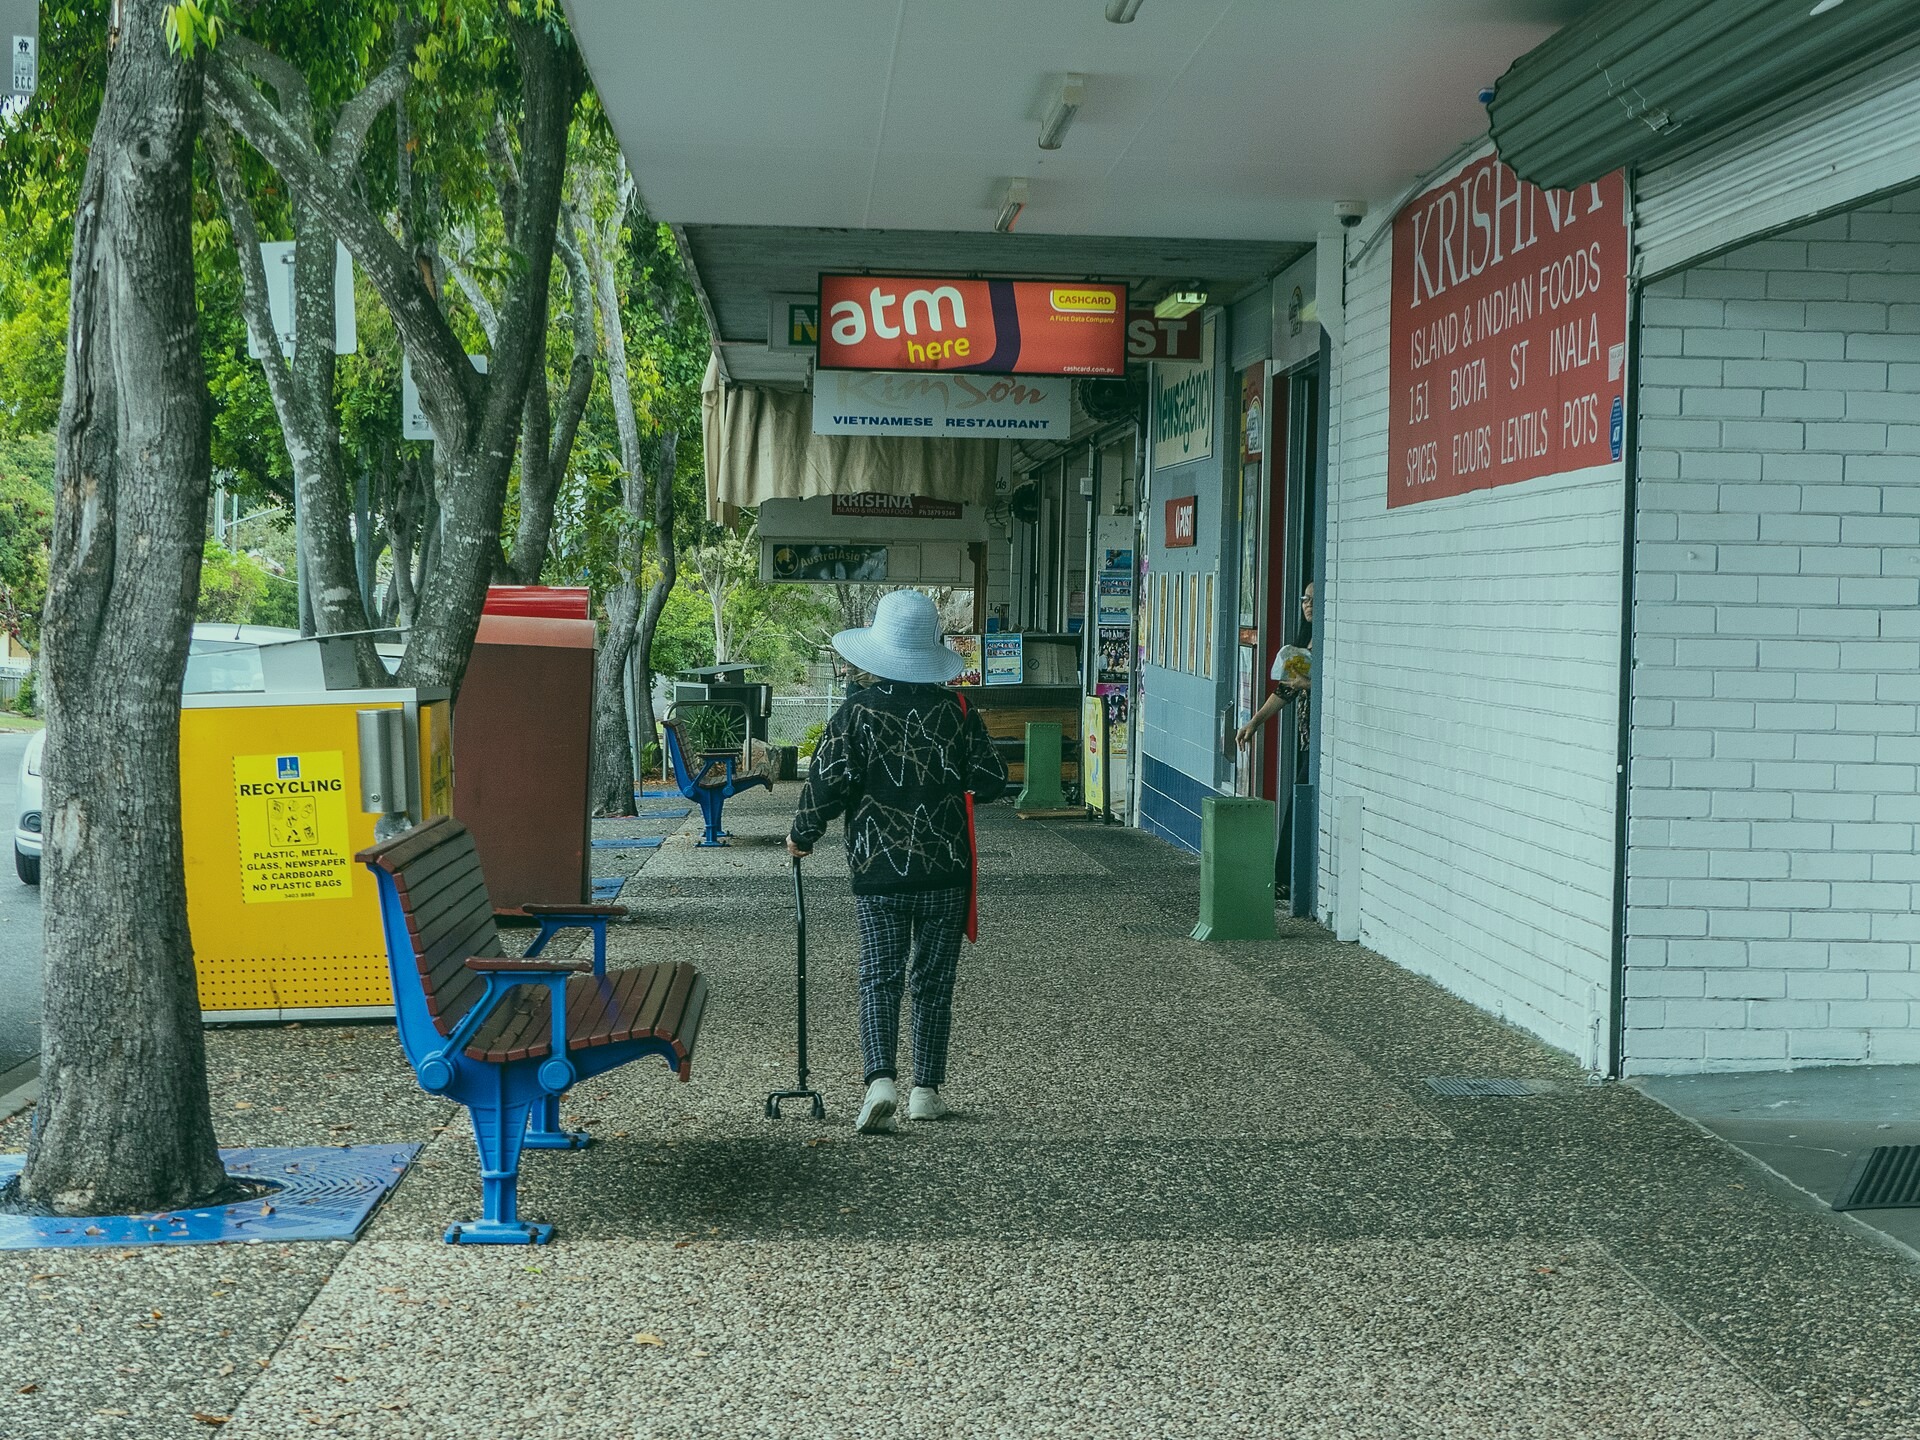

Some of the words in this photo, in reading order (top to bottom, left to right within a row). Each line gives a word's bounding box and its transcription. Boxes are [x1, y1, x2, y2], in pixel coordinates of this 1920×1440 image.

[1058, 295, 1111, 305] CASHCARD
[1410, 312, 1459, 370] ISLAND
[1462, 304, 1472, 348] &
[1477, 274, 1532, 342] INDIAN
[1539, 241, 1601, 315] FOODS
[831, 286, 967, 345] atm
[907, 337, 971, 363] here
[1063, 366, 1115, 374] cashcard.com.au
[1408, 383, 1430, 425] 151
[1450, 357, 1487, 411] BIOTA
[1509, 339, 1530, 390] ST
[1550, 312, 1600, 377] INALA
[1155, 368, 1211, 453] Newsagency
[833, 415, 933, 427] VIETNAMESE
[945, 418, 1050, 430] RESTAURANT
[1406, 441, 1438, 487] SPICES
[1452, 425, 1491, 476] FLOURS
[1500, 408, 1548, 465] LENTILS
[1563, 393, 1598, 449] POTS
[836, 494, 914, 509] KRISHNA
[891, 508, 913, 516] FOODS
[1180, 505, 1193, 538] POST
[240, 779, 342, 796] RECYCLING
[253, 850, 299, 860] PLASTIC,
[301, 848, 338, 857] METAL,
[247, 863, 282, 871] GLASS,
[285, 858, 346, 869] NEWSPAPER
[271, 869, 333, 881] CARDBOARD
[252, 884, 267, 892] NO
[270, 881, 312, 890] PLASTIC
[315, 879, 342, 887] BAGS
